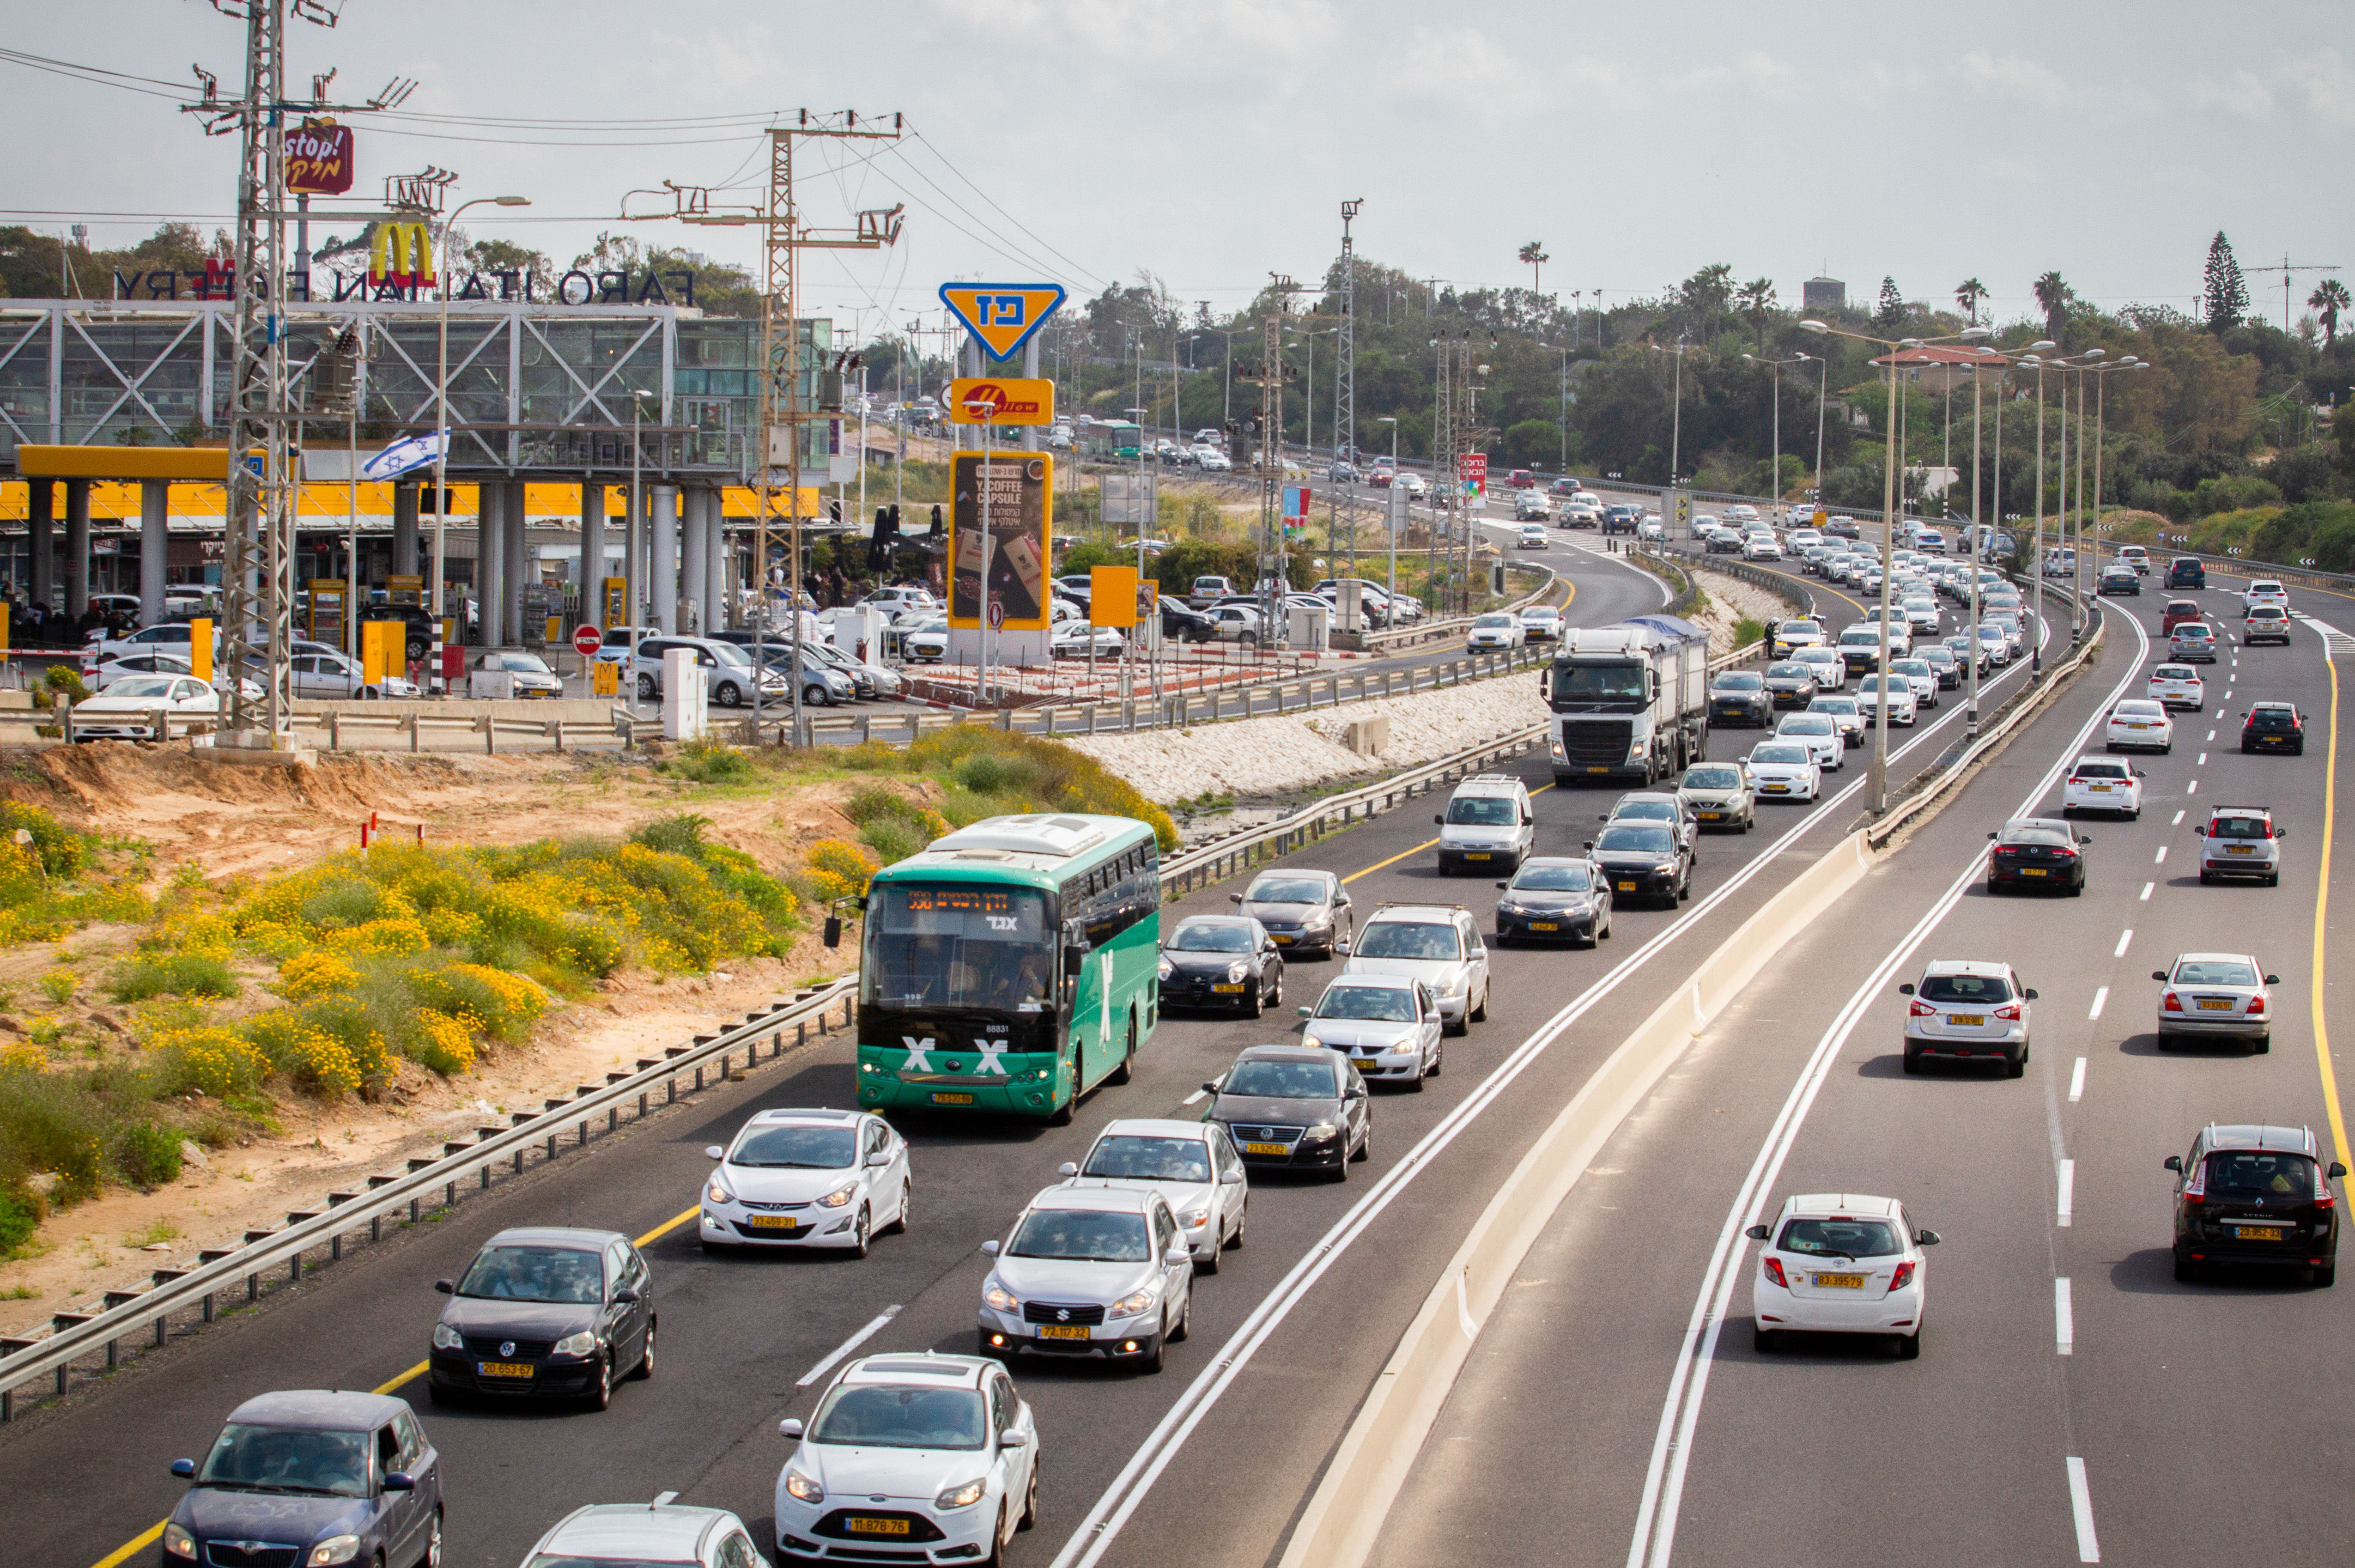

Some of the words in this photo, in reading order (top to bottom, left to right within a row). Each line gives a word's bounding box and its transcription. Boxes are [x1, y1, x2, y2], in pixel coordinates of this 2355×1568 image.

[285, 130, 344, 161] stop!
[976, 295, 1025, 326] פז
[986, 916, 1017, 930] אגד
